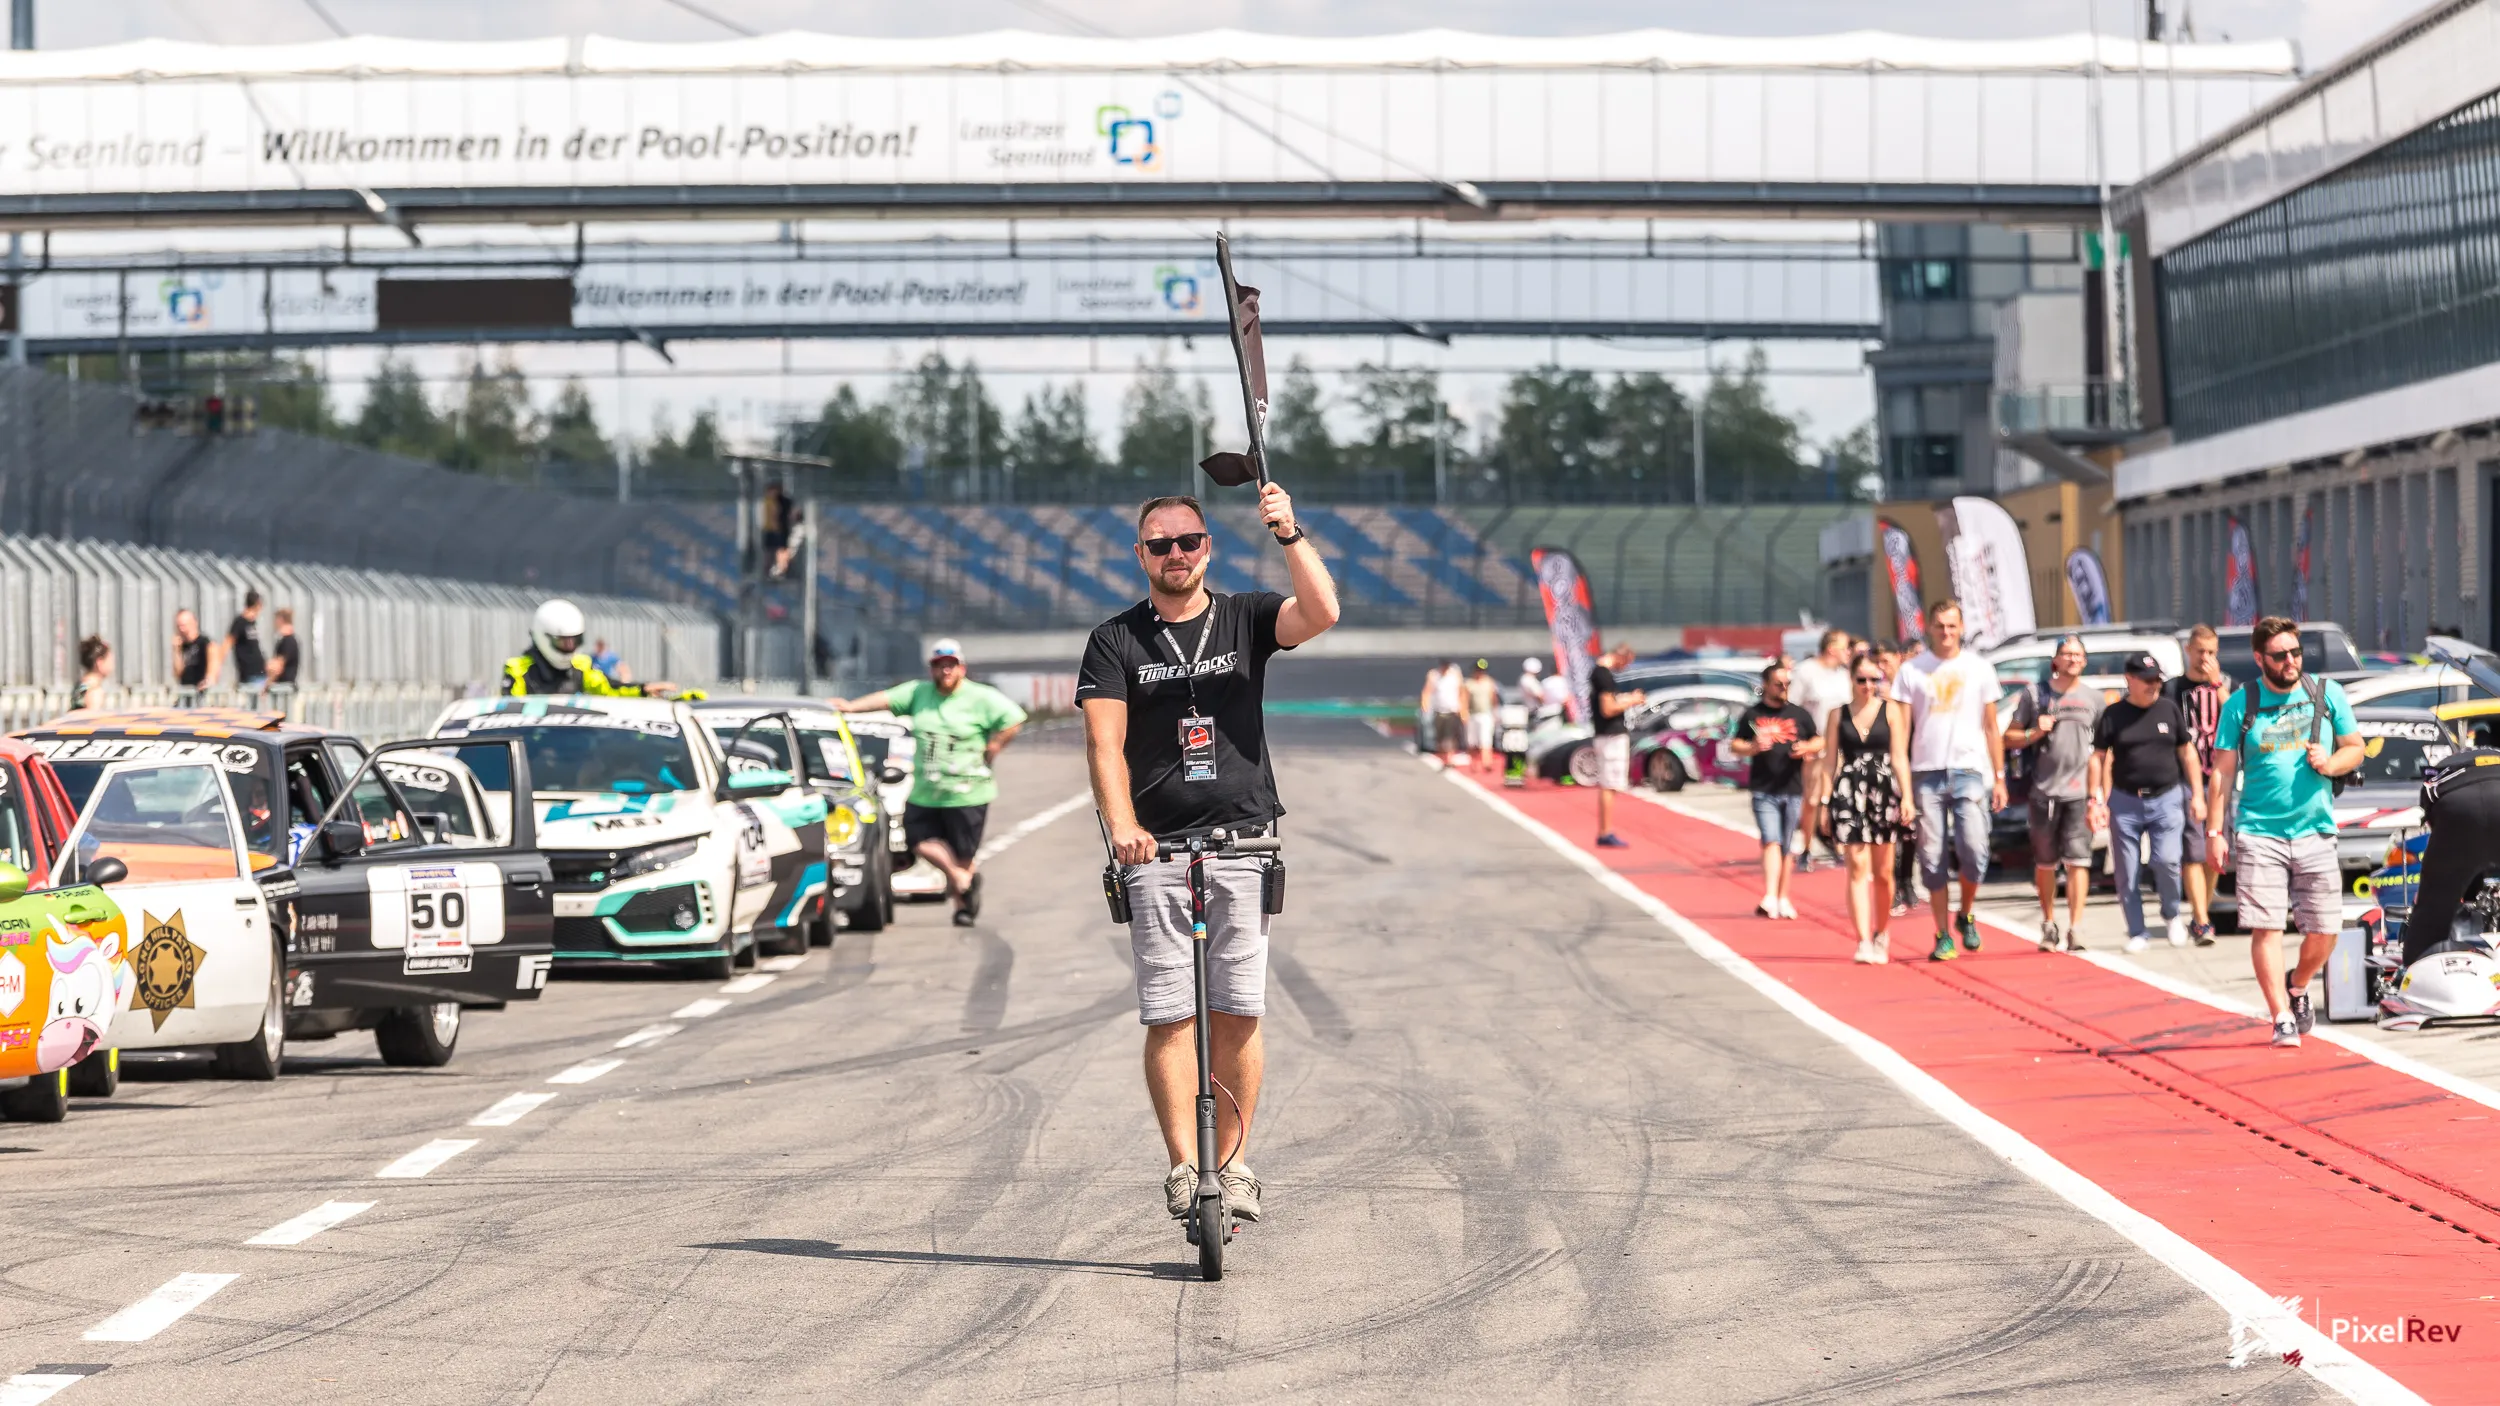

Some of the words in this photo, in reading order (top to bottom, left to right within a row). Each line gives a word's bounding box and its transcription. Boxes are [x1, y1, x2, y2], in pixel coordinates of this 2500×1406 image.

[25, 130, 209, 172] Seenland
[262, 129, 500, 165] Willkommen
[513, 126, 550, 161] in
[562, 125, 628, 161] der
[637, 124, 918, 160] Pool-Position!
[411, 892, 465, 929] 50
[144, 988, 184, 1010] OFFICER
